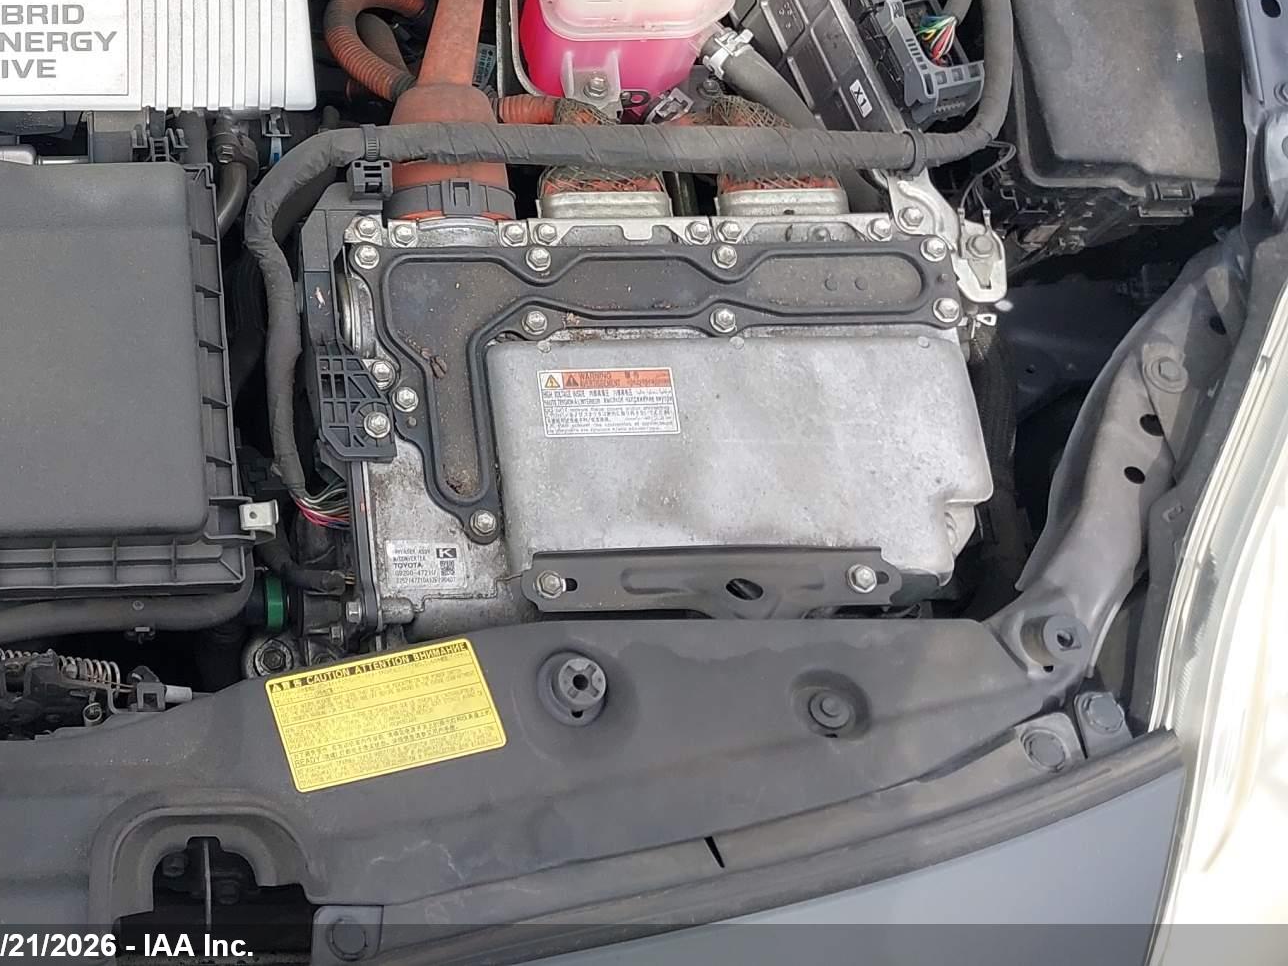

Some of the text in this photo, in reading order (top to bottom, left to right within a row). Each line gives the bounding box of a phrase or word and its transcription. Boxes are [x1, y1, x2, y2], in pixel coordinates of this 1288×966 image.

[854, 86, 867, 107] X1
[580, 372, 612, 380] WARNING
[306, 668, 350, 685] CAUTION
[354, 654, 410, 674] ATTENTION
[413, 642, 468, 664] ВНИМАНИЕ
